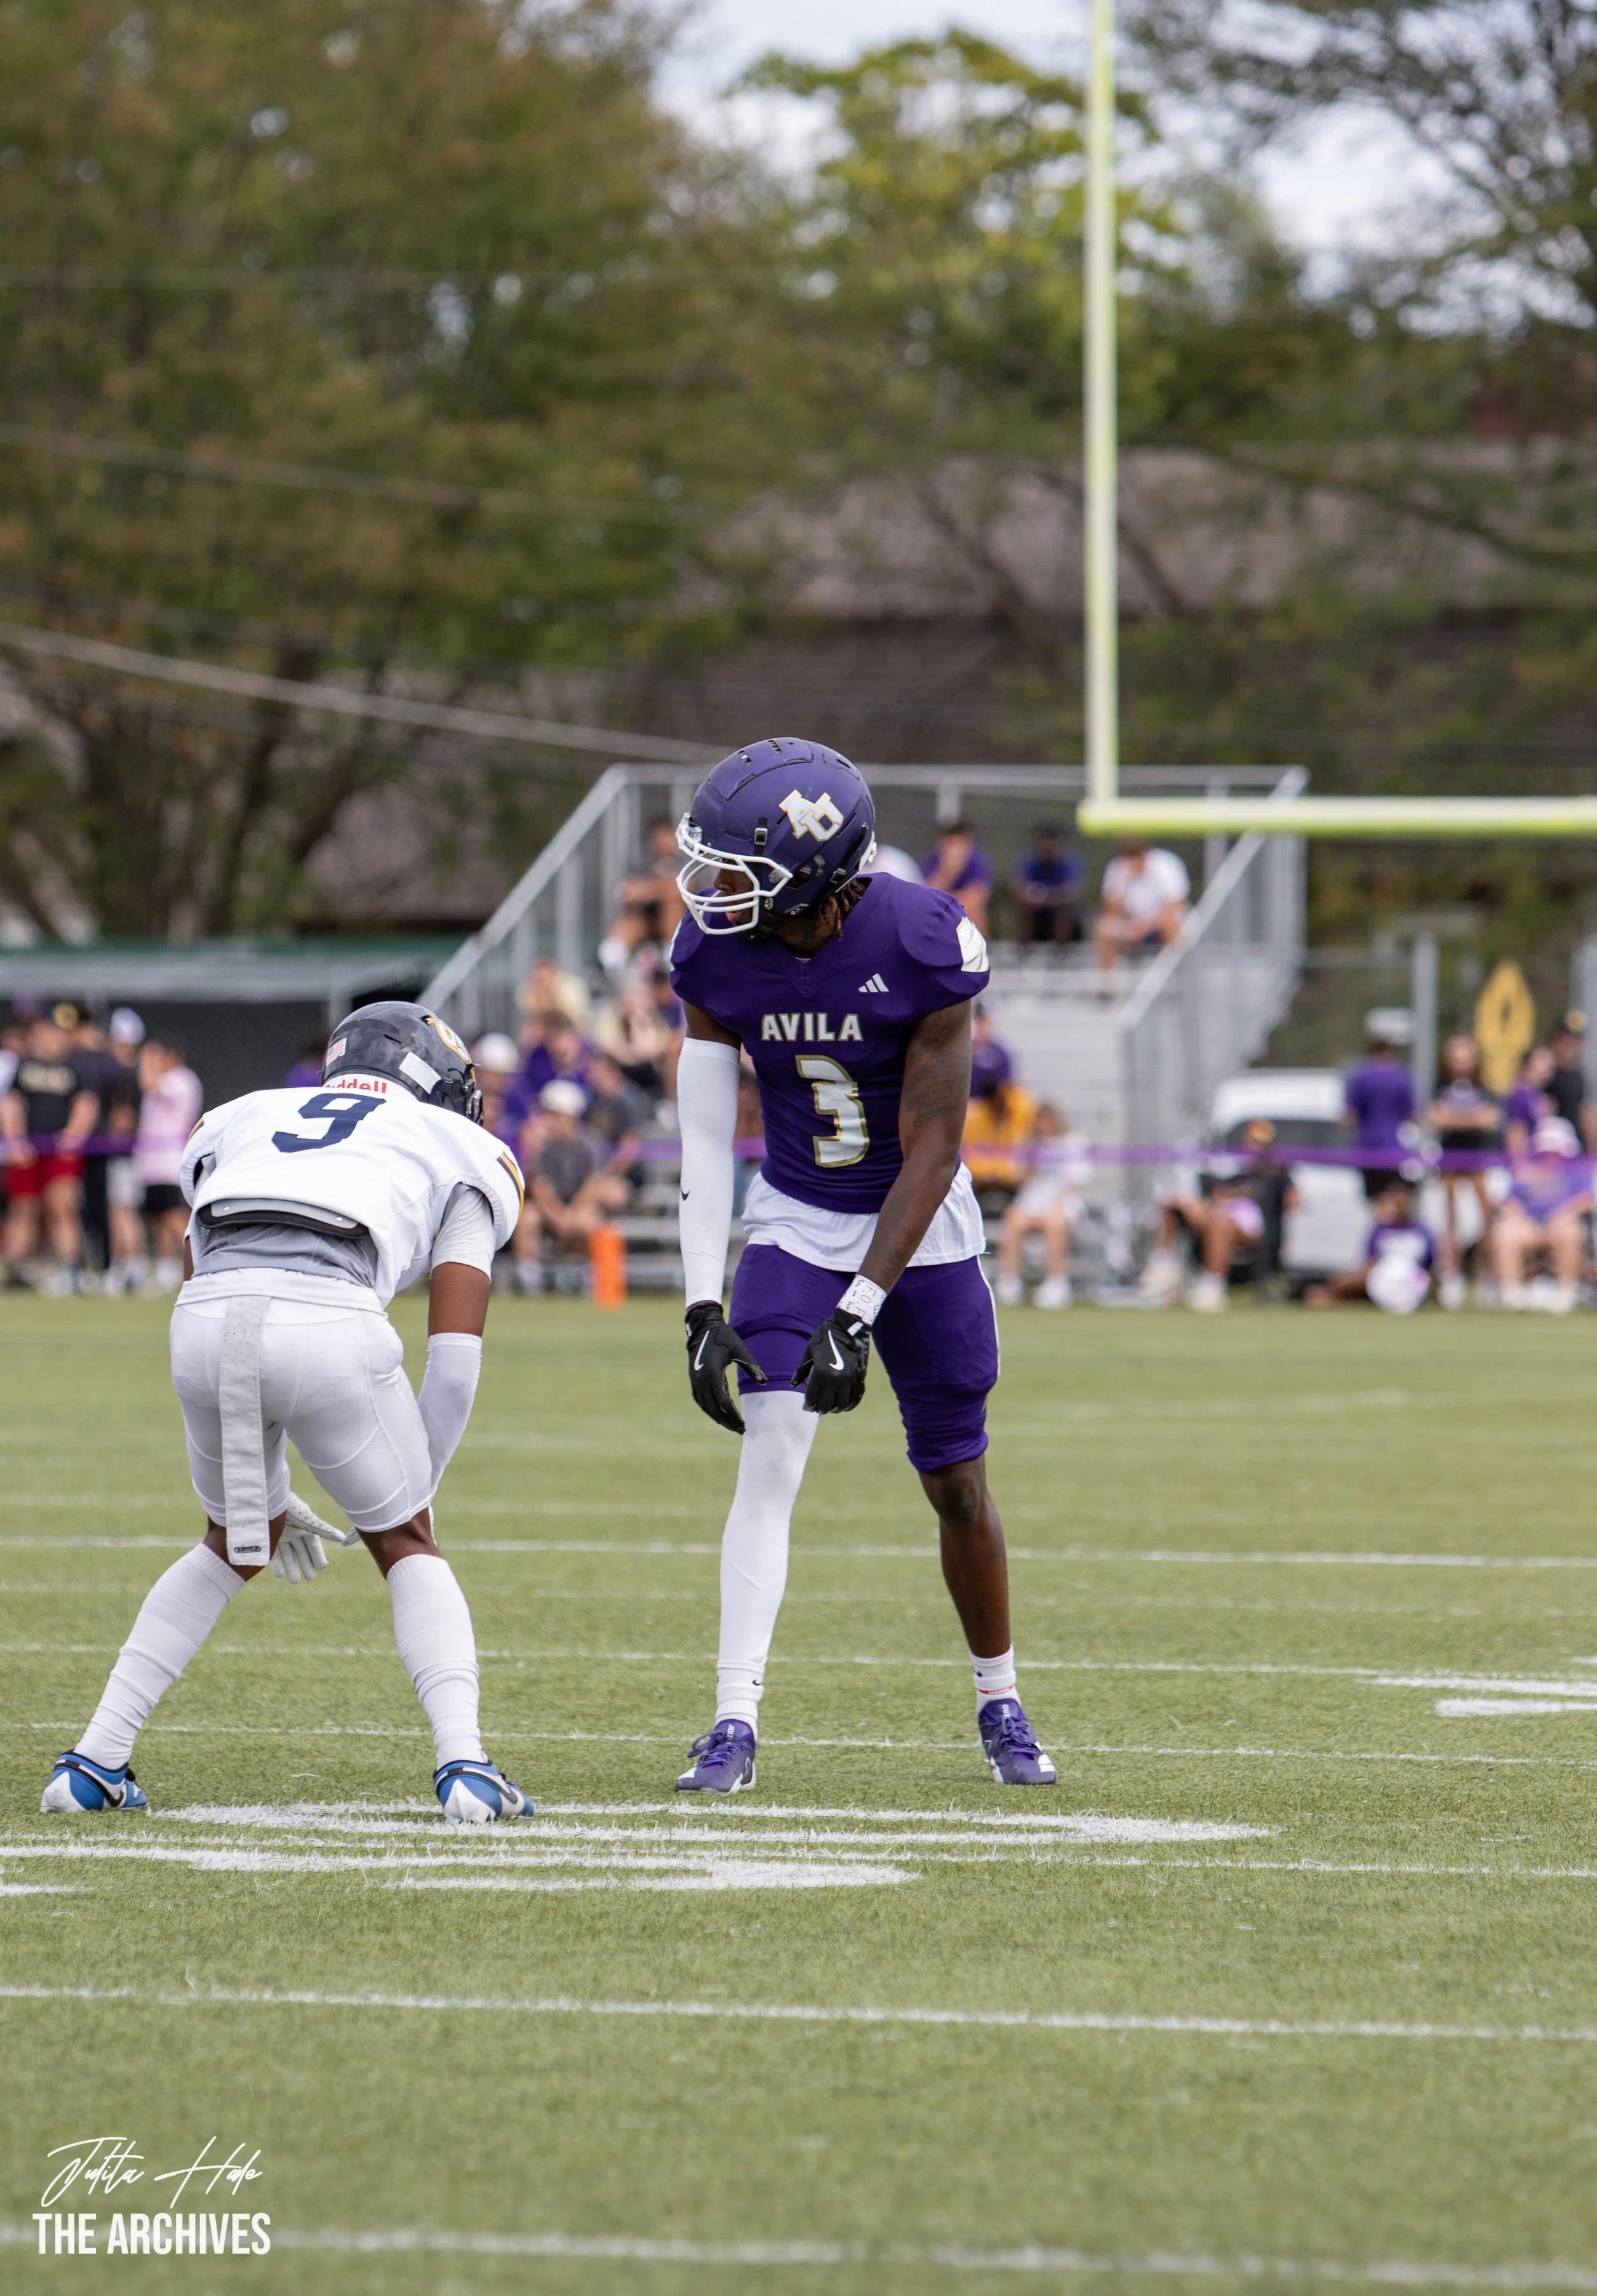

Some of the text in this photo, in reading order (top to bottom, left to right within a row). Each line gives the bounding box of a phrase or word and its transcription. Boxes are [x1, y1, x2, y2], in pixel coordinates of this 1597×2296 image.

[761, 1012, 863, 1042] AVILA
[325, 1079, 387, 1093] ddell
[271, 1093, 387, 1153] 9
[795, 1055, 869, 1167] 3
